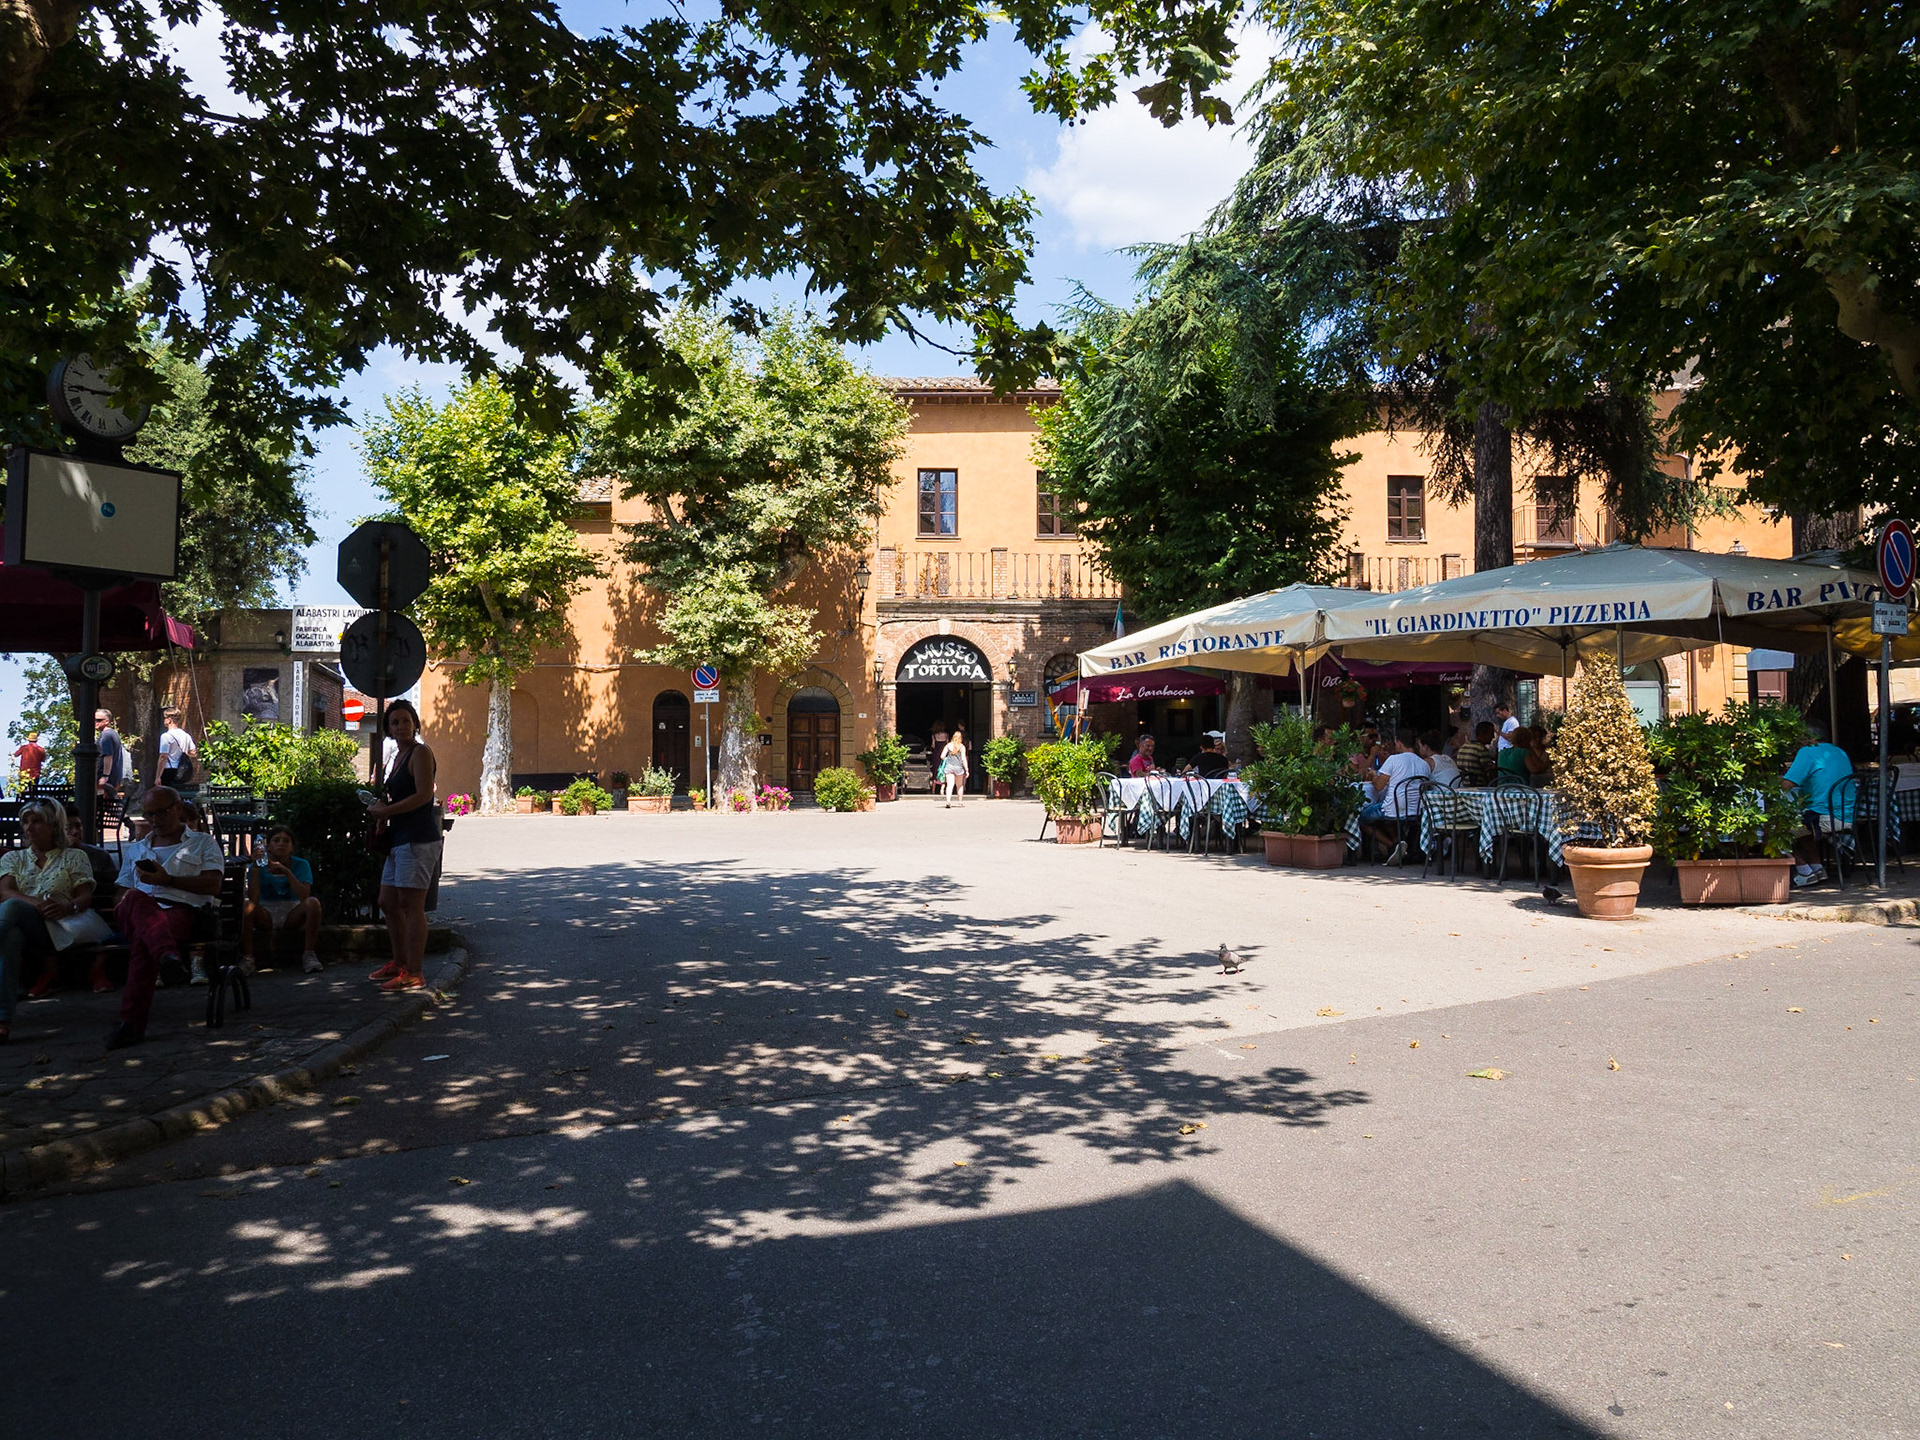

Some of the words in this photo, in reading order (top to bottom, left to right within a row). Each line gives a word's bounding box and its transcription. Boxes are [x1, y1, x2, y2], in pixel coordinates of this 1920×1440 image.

[1747, 587, 1802, 612] BAR
[295, 608, 340, 618] ALABASTRI
[1396, 607, 1542, 634] GIARDINETTO"
[1548, 600, 1651, 625] PIZZERIA
[295, 625, 328, 633] FABBRICA
[913, 641, 979, 665] MUSEO
[1109, 651, 1147, 670] BAR
[1158, 629, 1286, 659] RISTORANTE
[904, 664, 987, 680] TORTURA
[1116, 688, 1134, 701] La
[1137, 685, 1195, 698] Carabaccia
